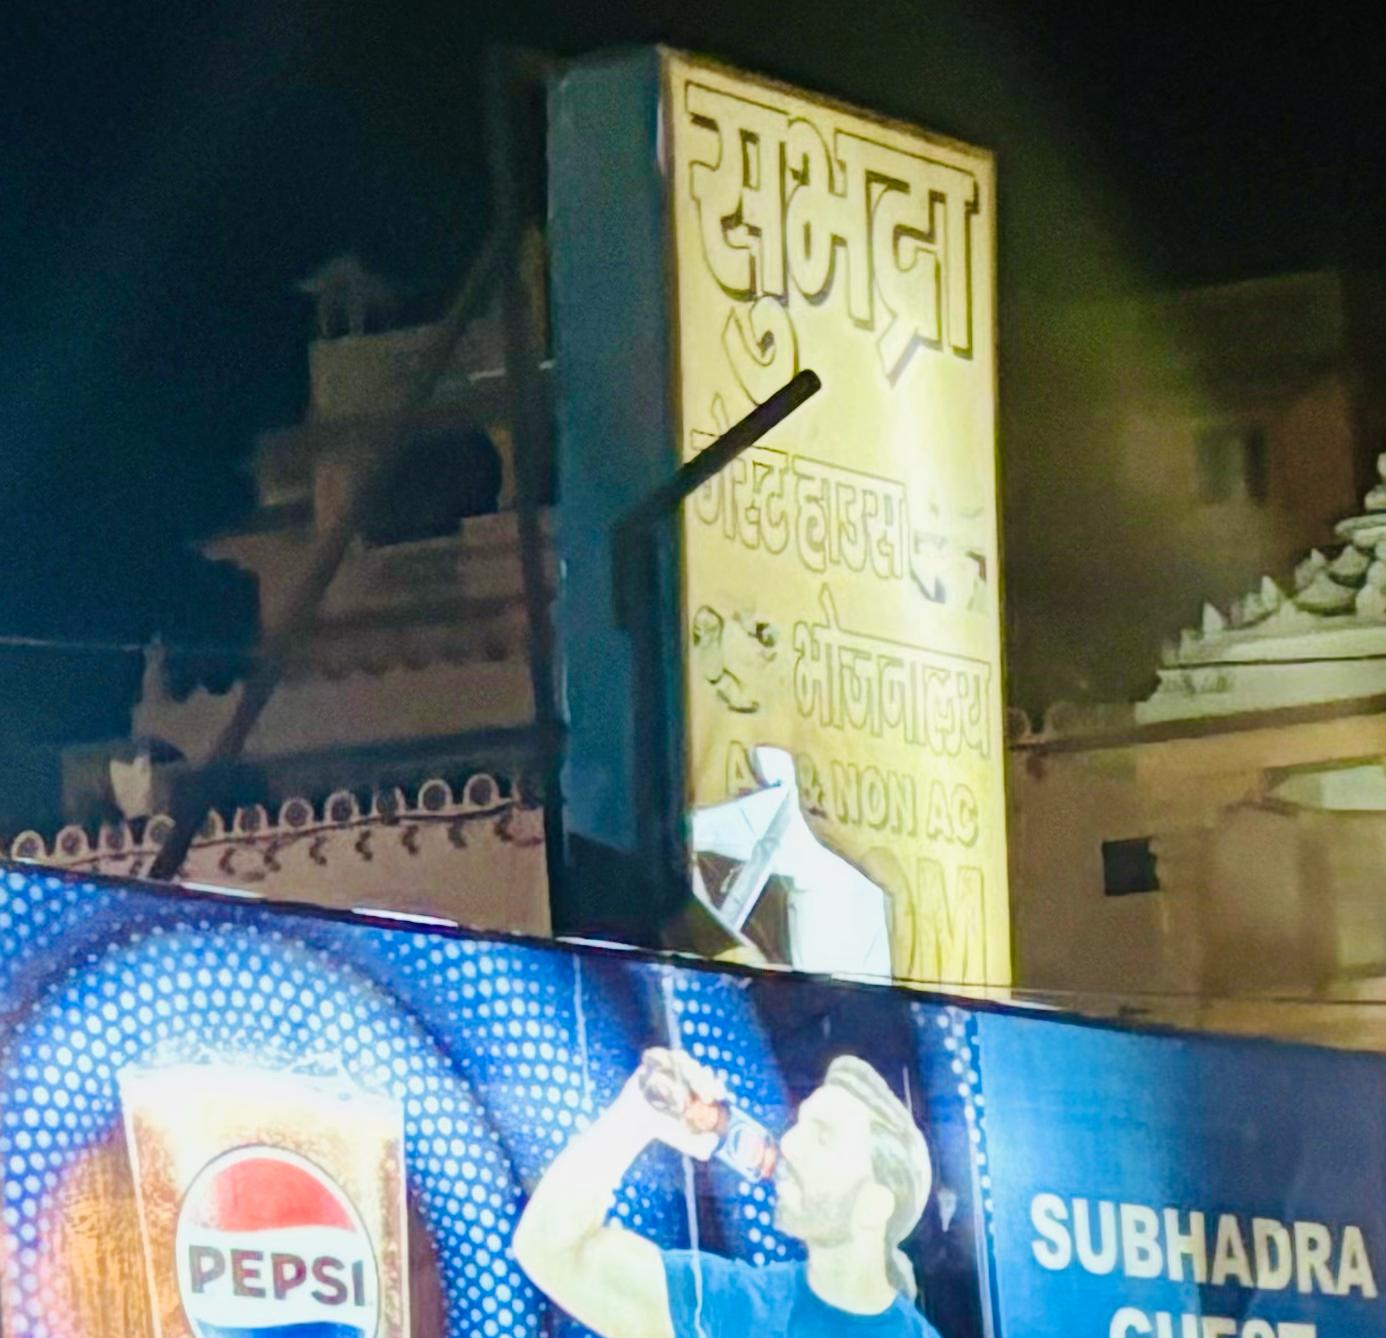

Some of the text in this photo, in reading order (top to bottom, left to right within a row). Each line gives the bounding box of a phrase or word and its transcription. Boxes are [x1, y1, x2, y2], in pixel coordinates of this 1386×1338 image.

[685, 79, 982, 408] सुभद्रा
[791, 454, 906, 582] हाउस
[794, 582, 993, 760] भोजनालय
[831, 759, 918, 838] NON
[925, 778, 980, 848] AC
[187, 1244, 367, 1307] PEPSI
[1030, 1192, 1379, 1299] SUBHADRA
